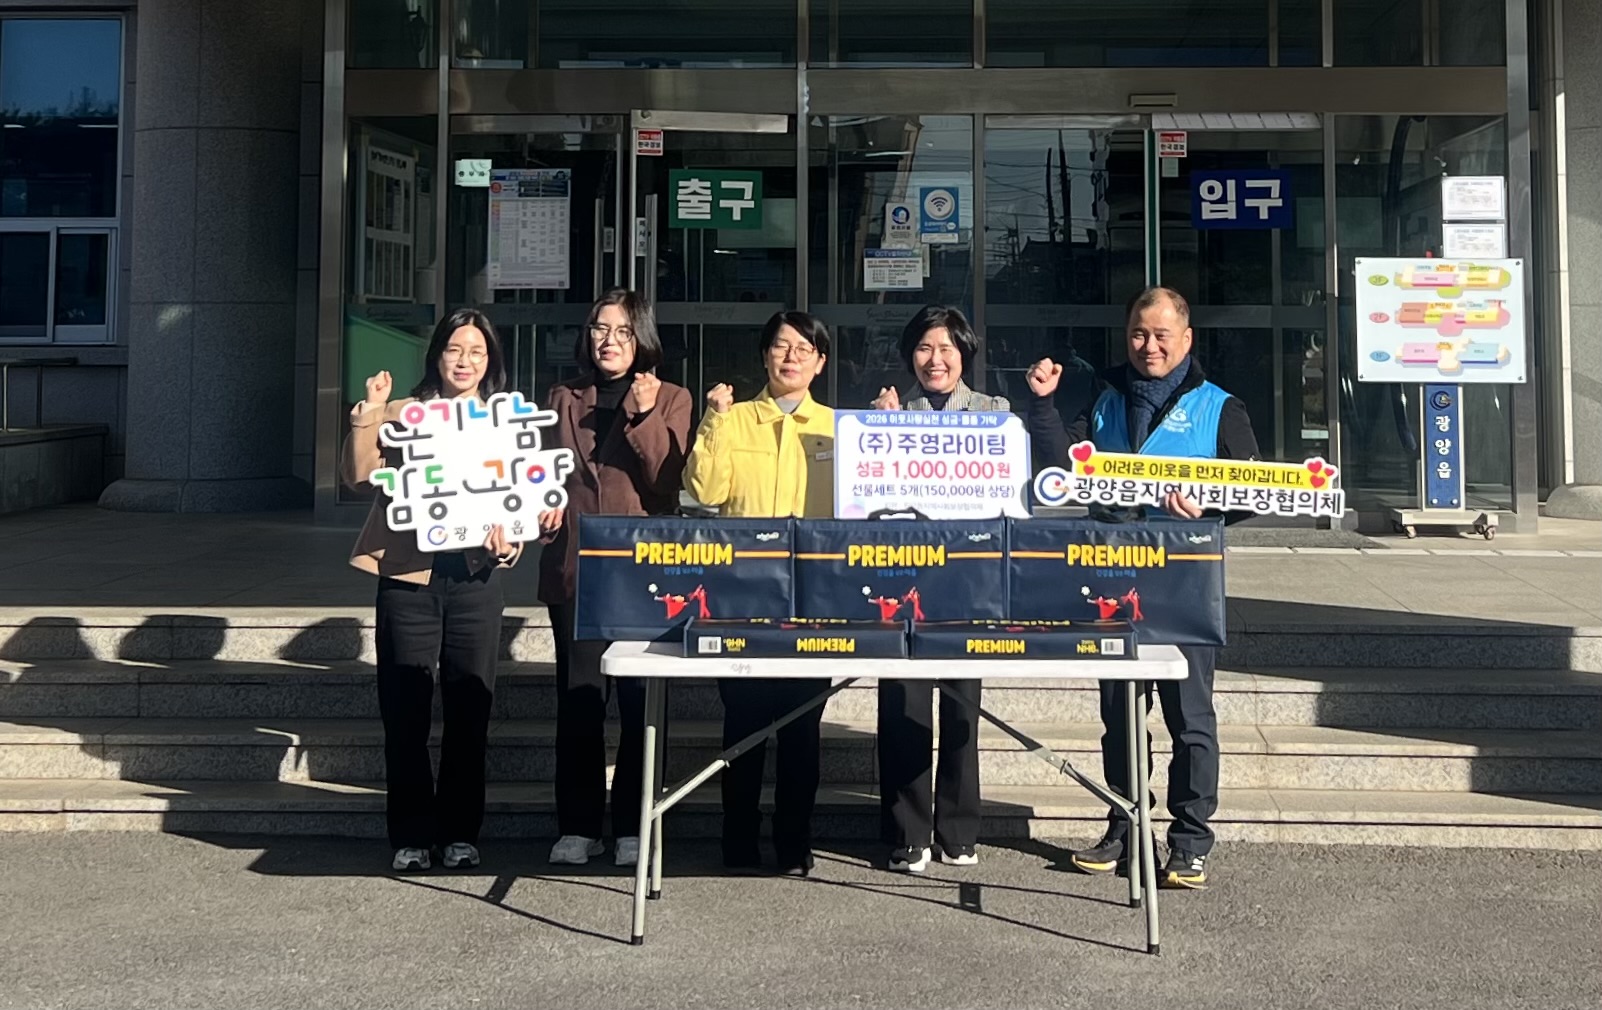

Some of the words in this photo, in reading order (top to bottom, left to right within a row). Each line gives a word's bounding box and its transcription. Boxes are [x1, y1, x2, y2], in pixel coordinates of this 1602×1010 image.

[677, 178, 755, 221] 출구
[1199, 179, 1283, 220] 입구
[384, 396, 553, 460] 온기나눔
[865, 413, 888, 424] 2026
[981, 414, 998, 426] 기탁
[1435, 415, 1452, 480] 광양읍
[856, 461, 885, 478] 성금
[891, 460, 1011, 481] 1,000,000원
[1103, 460, 1145, 475] 어려운
[1149, 461, 1191, 477] 이웃을
[1196, 464, 1224, 481] 먼저
[1228, 466, 1305, 487] 찾아갑니다.
[852, 484, 896, 497] 선물세트
[988, 485, 1015, 498] 상당)
[635, 542, 733, 566] PREMIUM
[848, 544, 946, 567] PREMIUM
[1067, 544, 1166, 568] PREMIUM
[796, 638, 856, 653] PREMIUM
[966, 639, 1026, 654] PREMIUM
